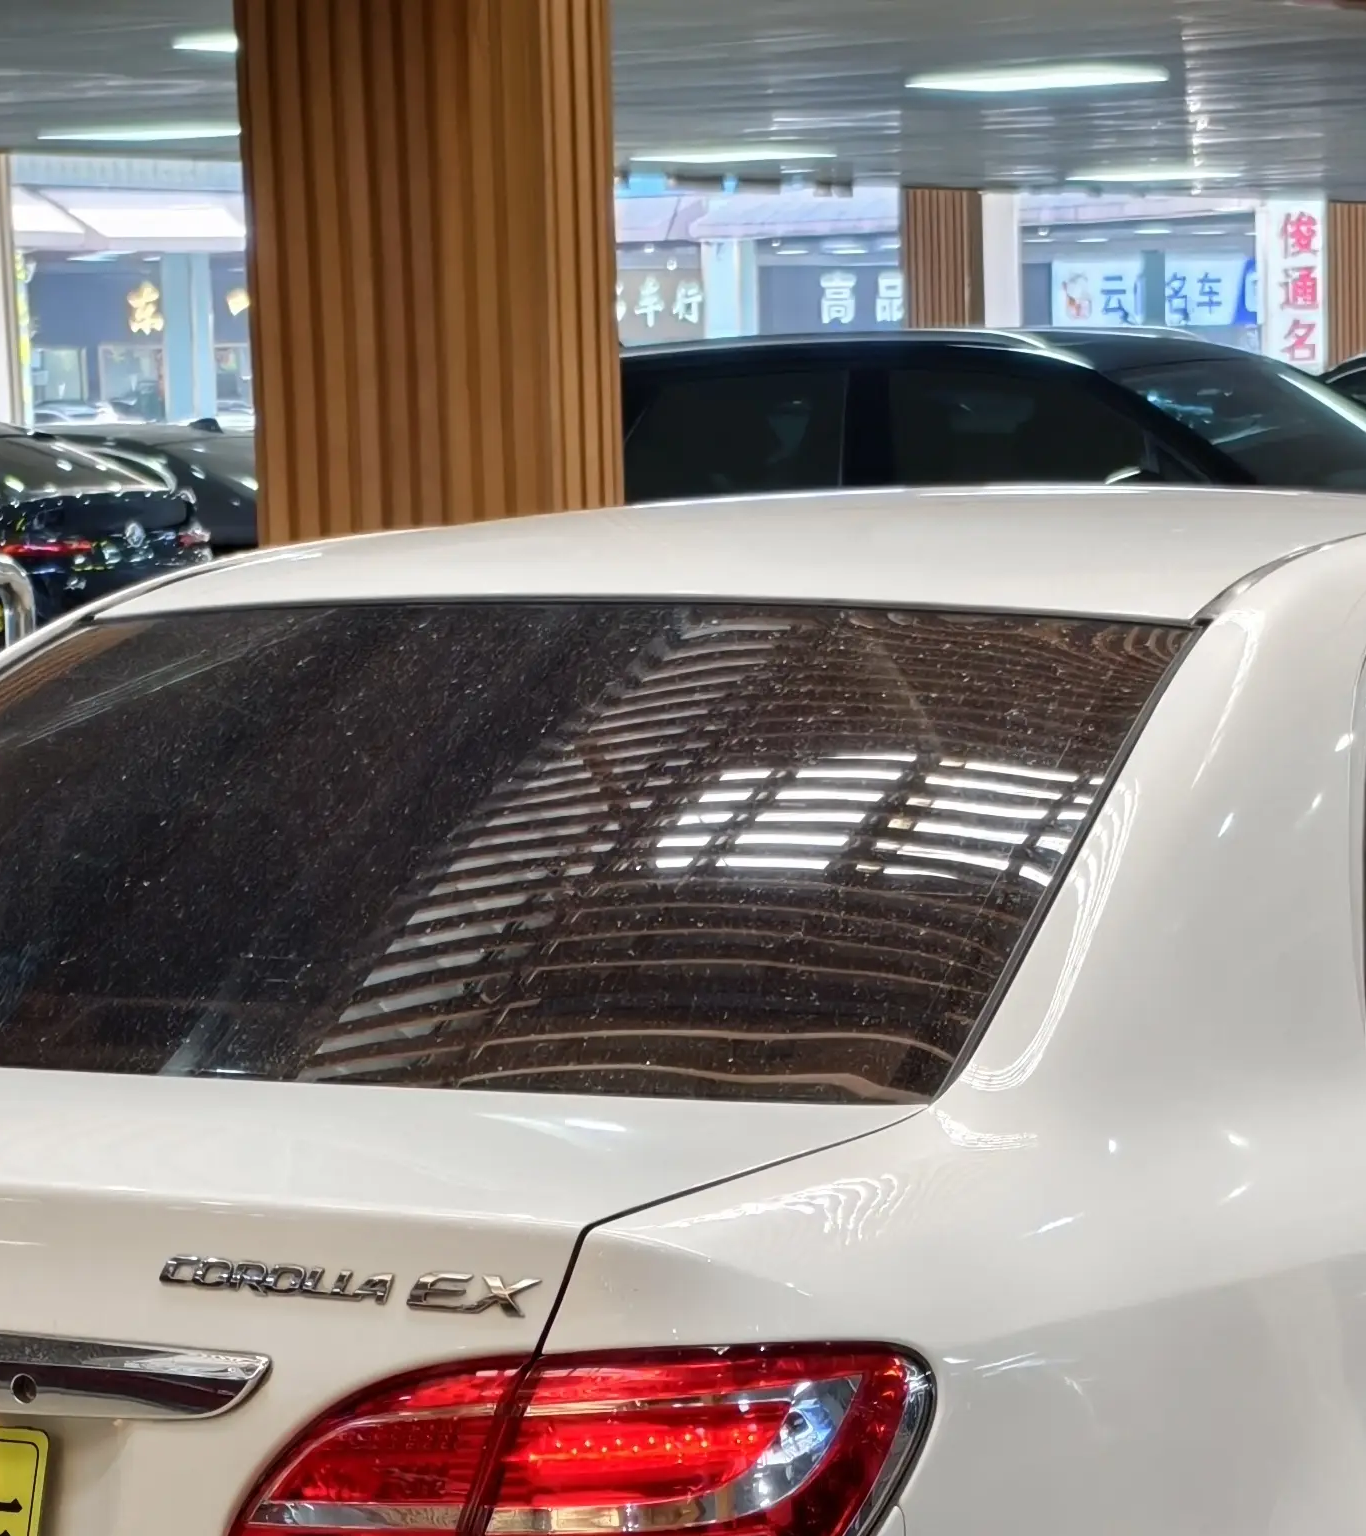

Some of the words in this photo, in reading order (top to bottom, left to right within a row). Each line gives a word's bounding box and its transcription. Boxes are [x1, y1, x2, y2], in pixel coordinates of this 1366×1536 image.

[1101, 270, 1222, 324] 云名车
[158, 1254, 397, 1306] COROLLA
[406, 1271, 544, 1319] EX
